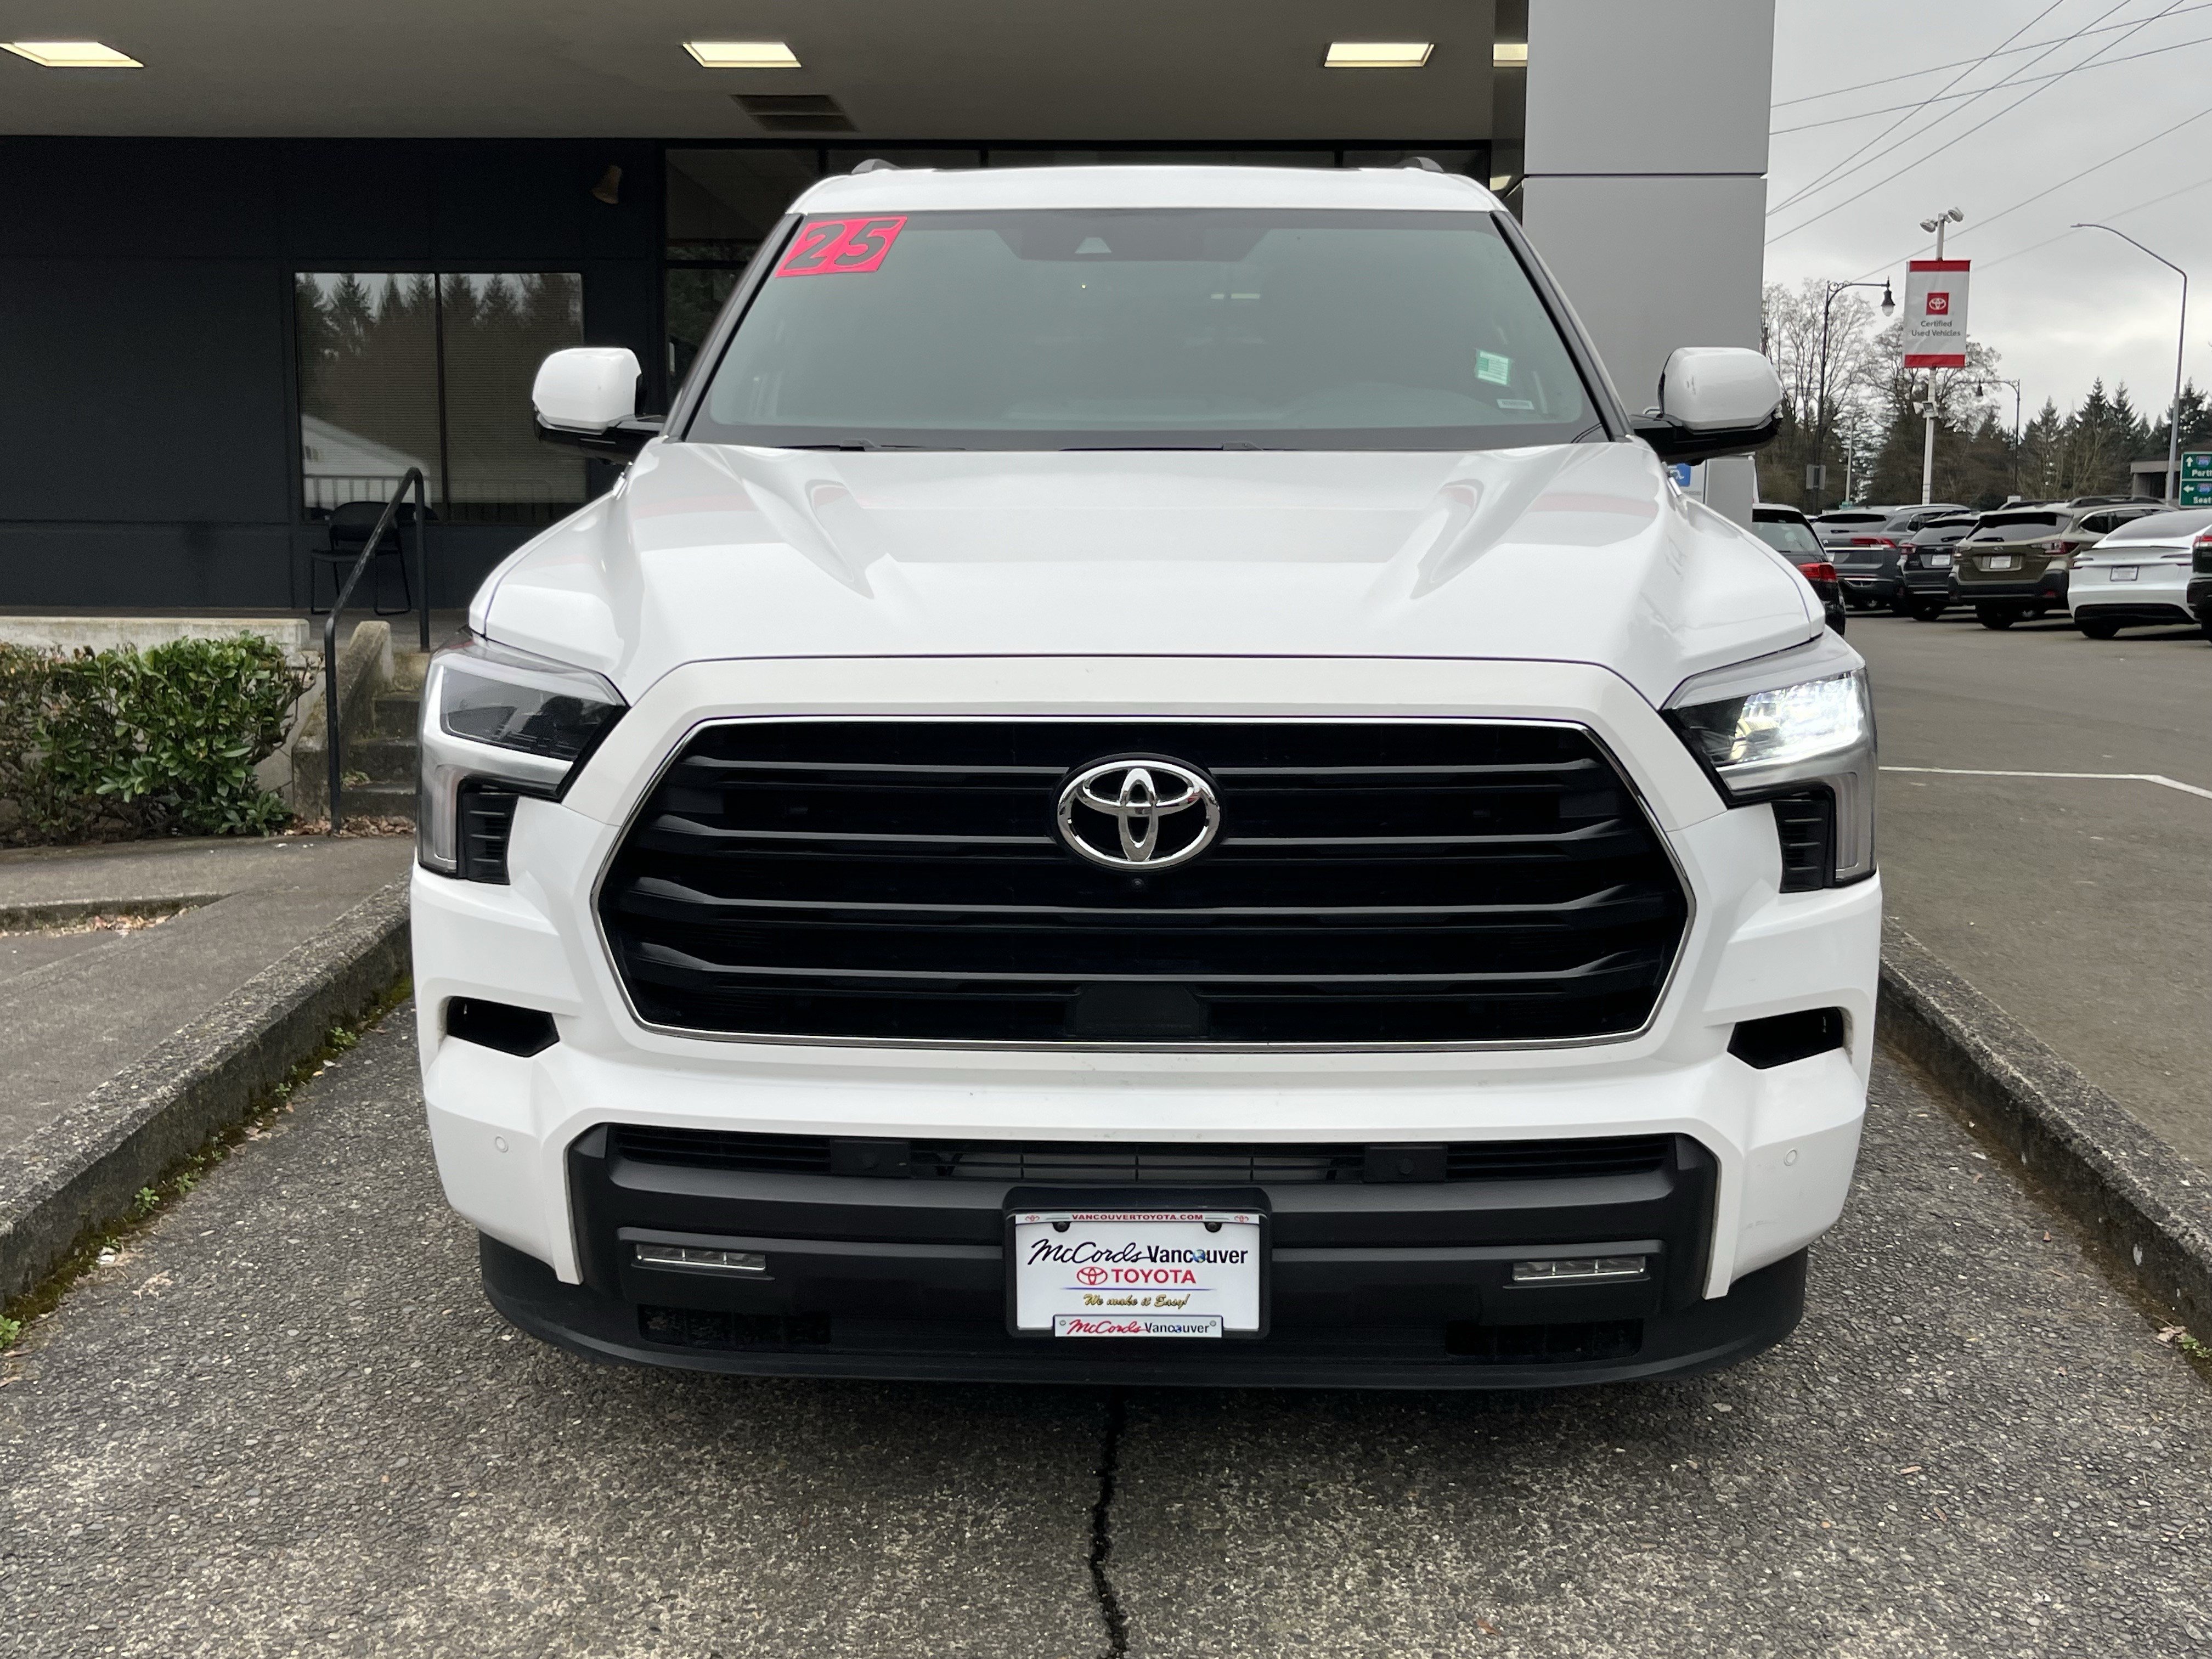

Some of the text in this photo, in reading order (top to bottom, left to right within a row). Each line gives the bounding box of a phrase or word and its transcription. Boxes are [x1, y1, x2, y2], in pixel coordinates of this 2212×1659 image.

[785, 220, 901, 269] 25
[1111, 1268, 1197, 1283] TOYOTA
[1084, 1294, 1191, 1310] We make it Easy!
